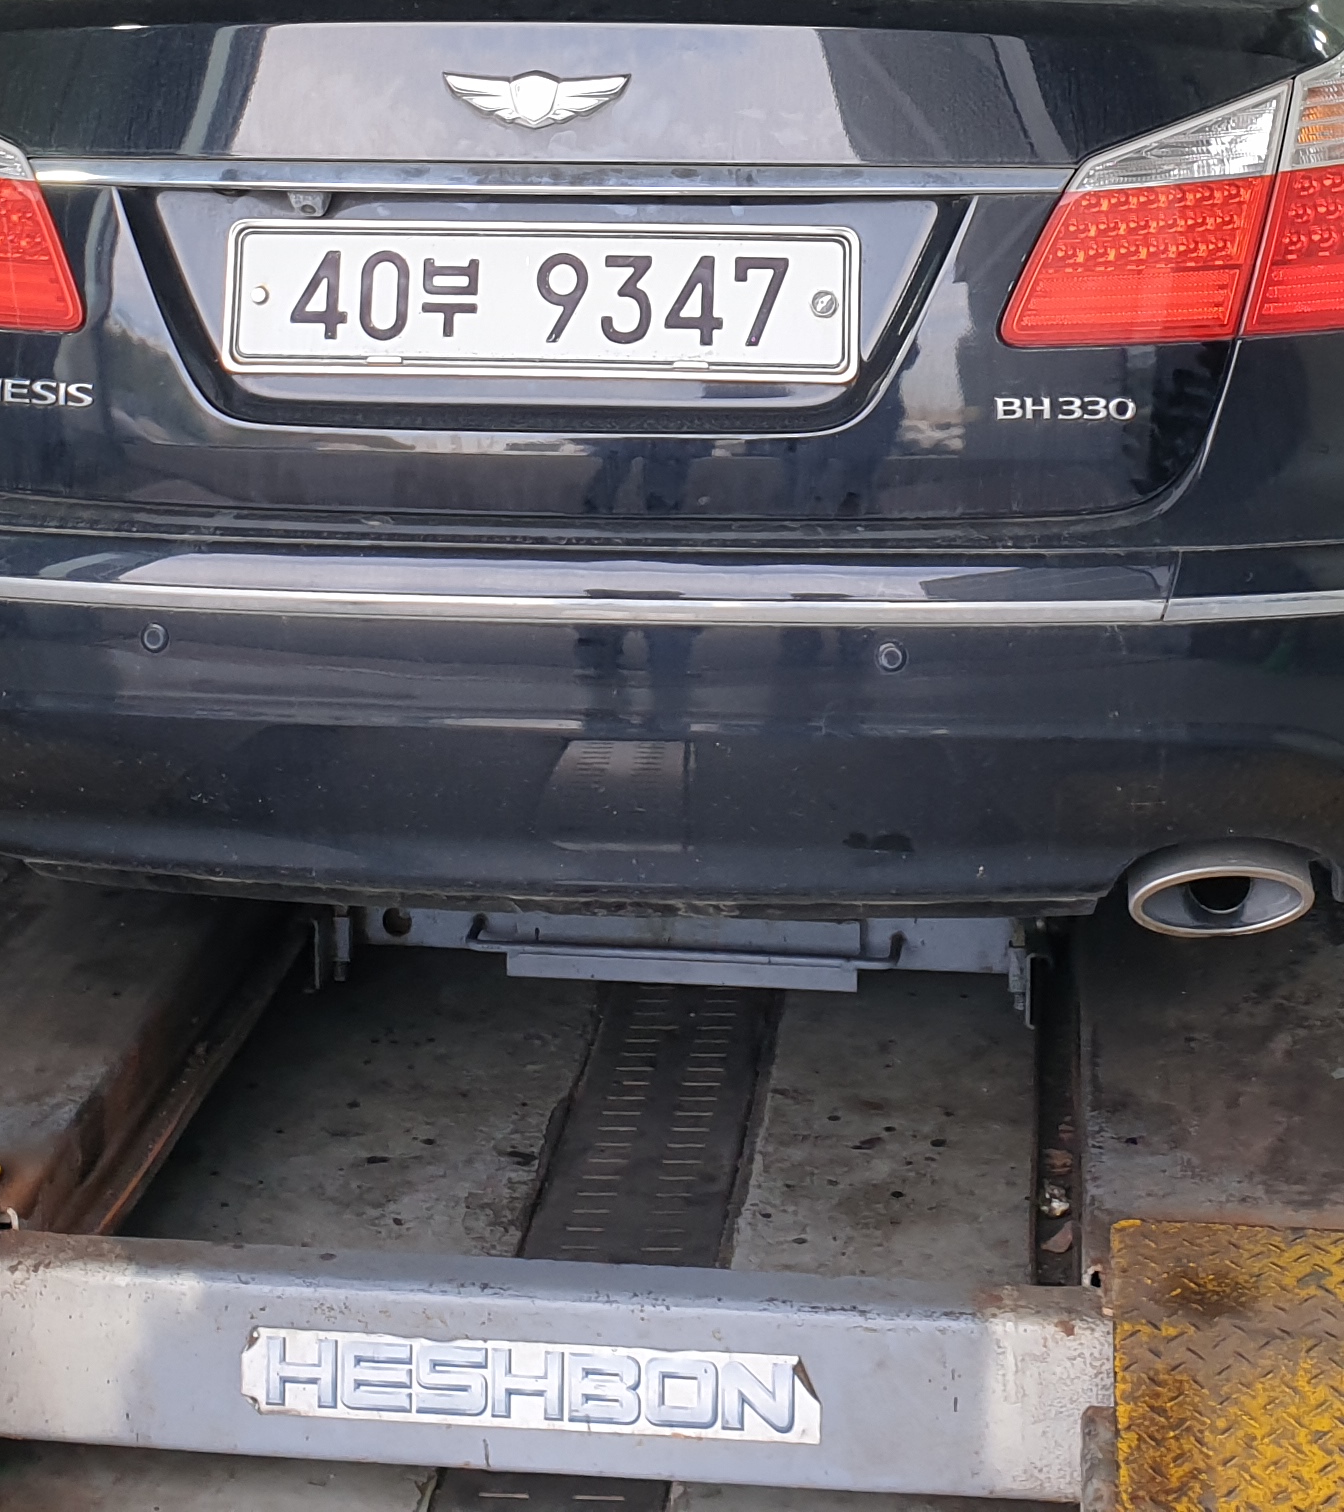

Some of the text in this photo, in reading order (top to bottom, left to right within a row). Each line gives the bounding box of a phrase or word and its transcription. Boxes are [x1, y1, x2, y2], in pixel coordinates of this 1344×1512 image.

[290, 251, 789, 347] 40부 9347
[265, 1334, 797, 1436] HESHBON
